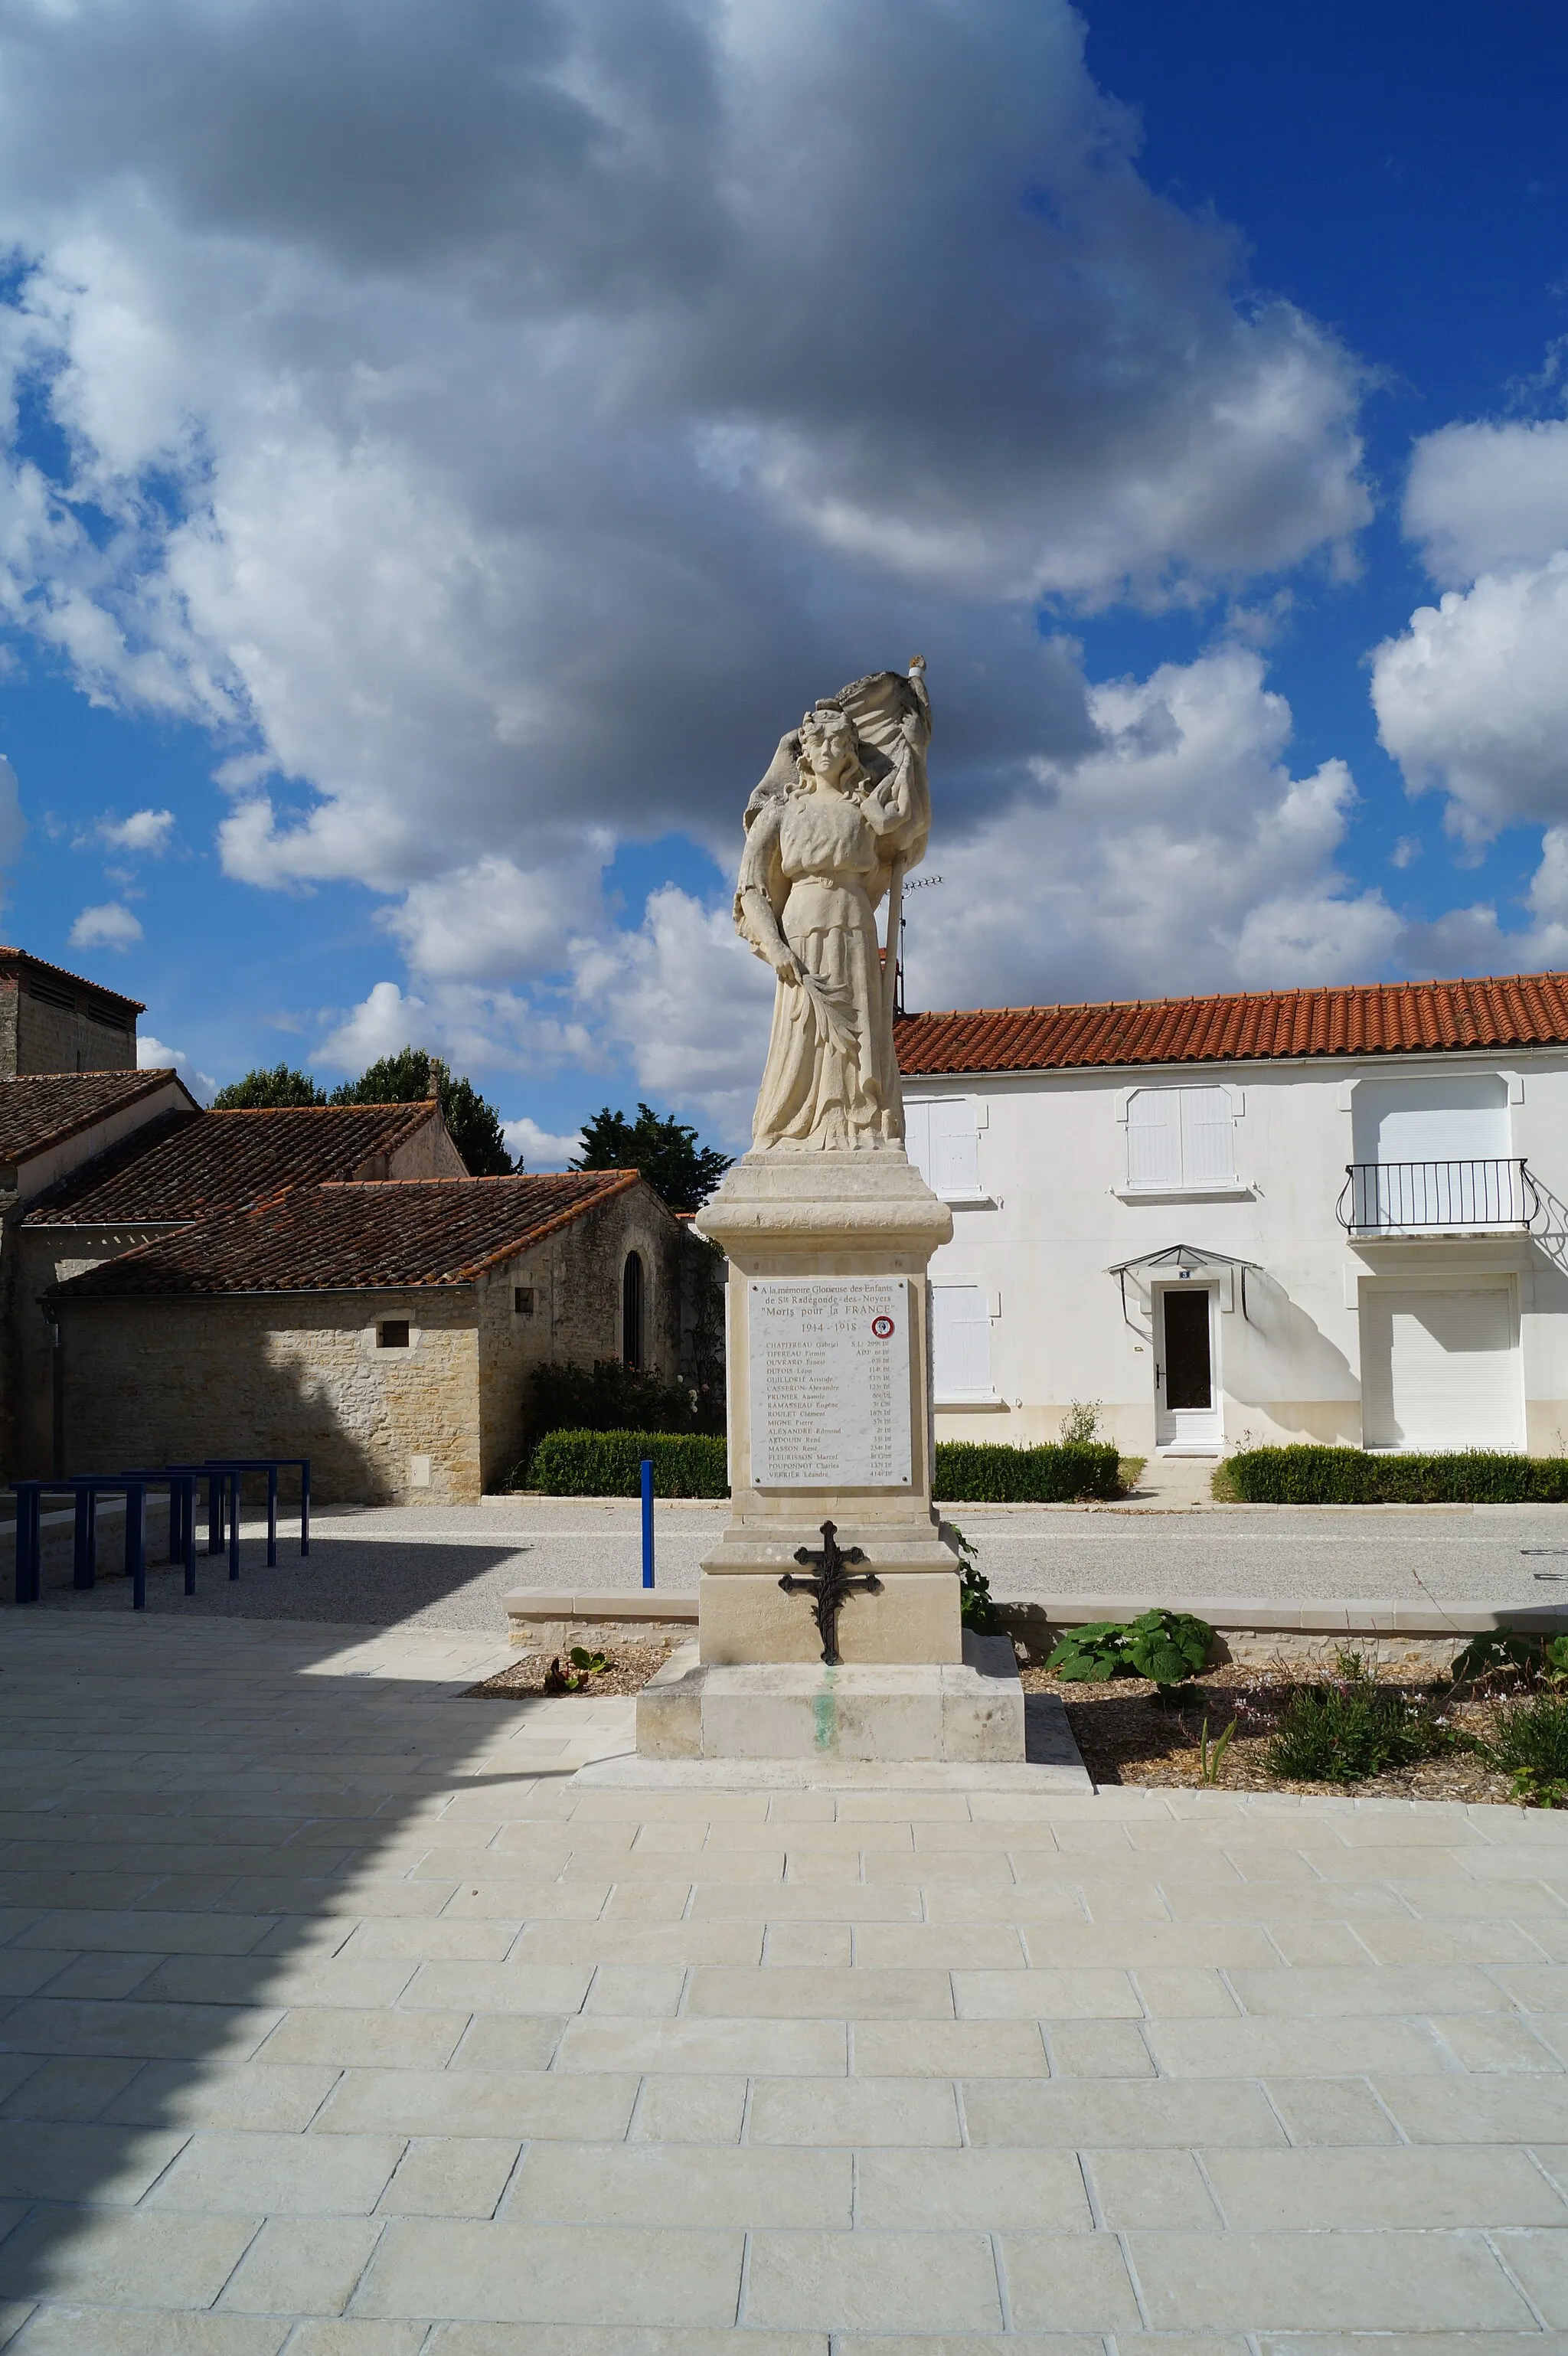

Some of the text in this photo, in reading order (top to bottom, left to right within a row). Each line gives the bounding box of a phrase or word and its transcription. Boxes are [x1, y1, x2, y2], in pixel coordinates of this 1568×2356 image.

[778, 1286, 810, 1294] mémoire
[864, 1284, 893, 1292] Enfants
[761, 1305, 896, 1317] "Morts pour la FRANCE"
